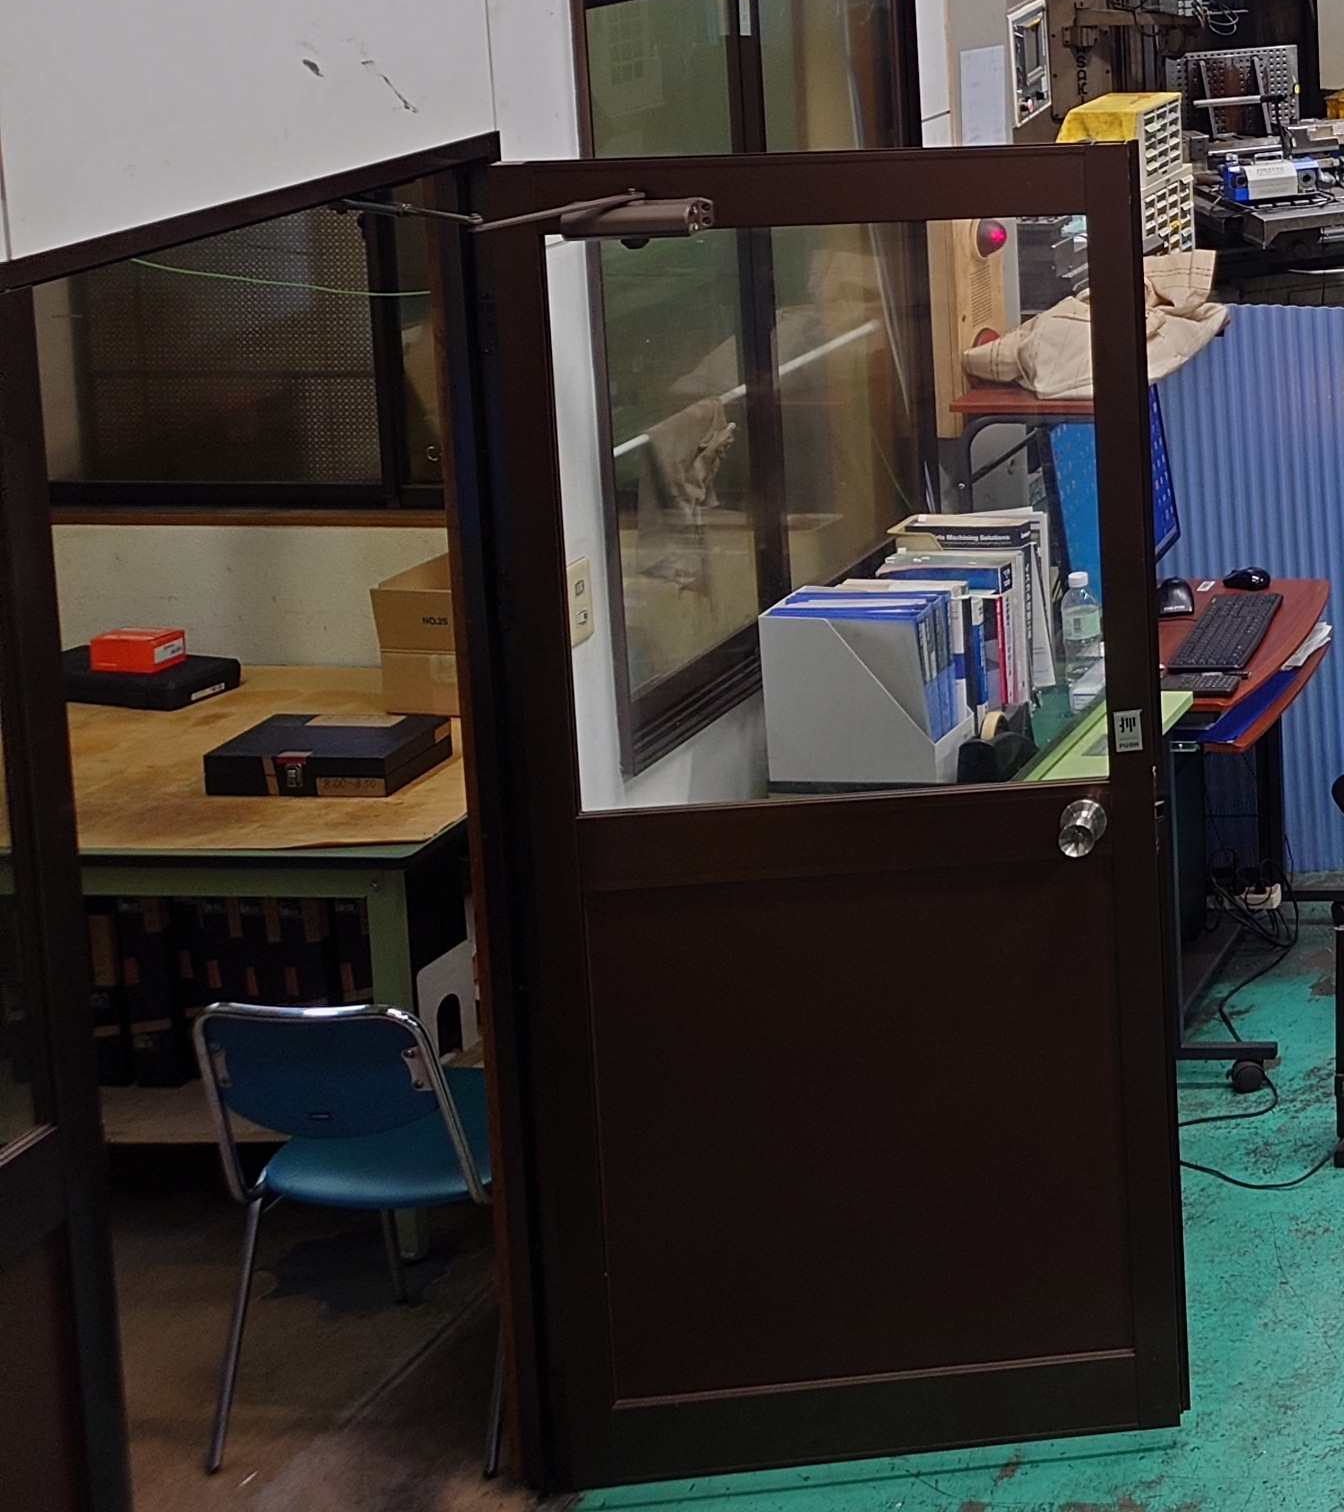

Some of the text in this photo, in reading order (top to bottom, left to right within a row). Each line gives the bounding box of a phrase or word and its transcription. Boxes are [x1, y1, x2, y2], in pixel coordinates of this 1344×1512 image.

[422, 616, 448, 626] NO.25
[1119, 716, 1137, 733] 押
[1118, 741, 1140, 749] PUSH
